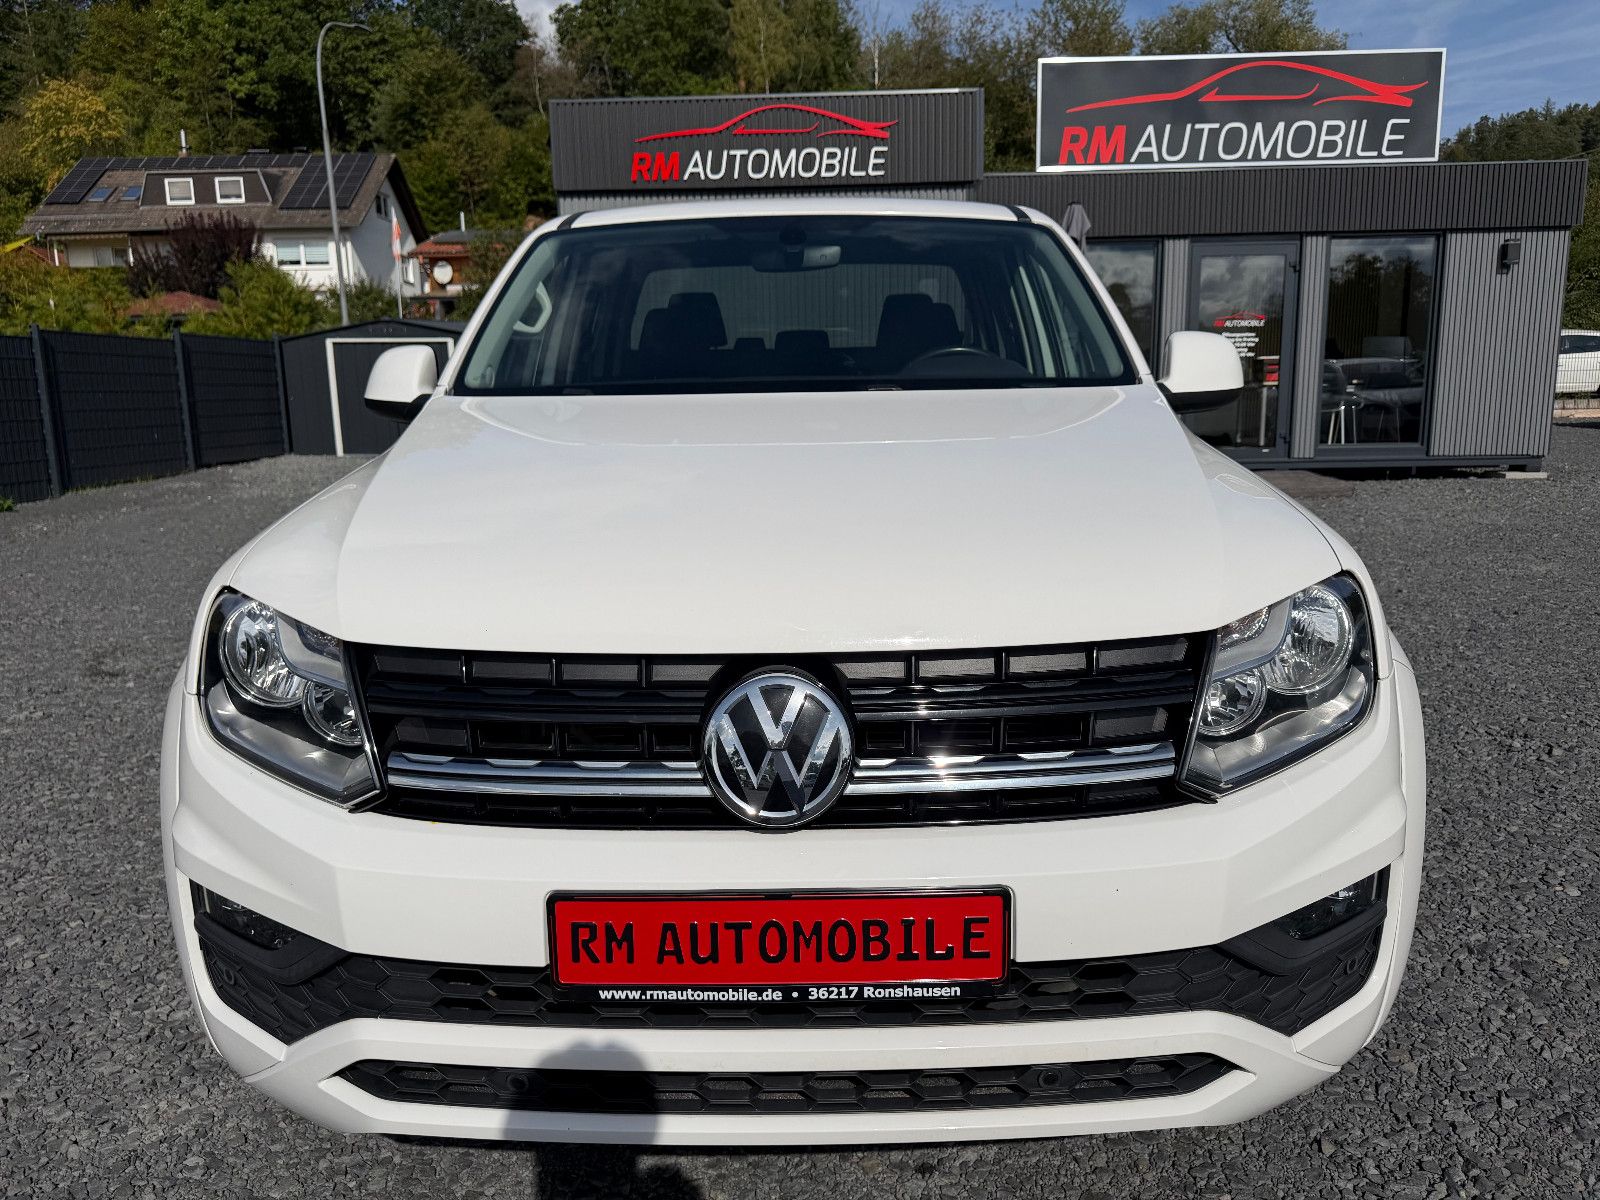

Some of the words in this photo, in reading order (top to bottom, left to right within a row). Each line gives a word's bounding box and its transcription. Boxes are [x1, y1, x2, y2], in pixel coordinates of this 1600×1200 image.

[1058, 125, 1127, 165] RM
[1129, 118, 1411, 163] AUTOMOBILE
[631, 152, 680, 182] RM
[683, 145, 889, 181] AUTOMOBILE
[570, 920, 635, 965] RM
[656, 916, 991, 965] AUTOMOBILE
[598, 988, 783, 1001] www.rmautomobile.de
[808, 986, 859, 1000] 36217
[863, 985, 961, 998] Ronshausen
